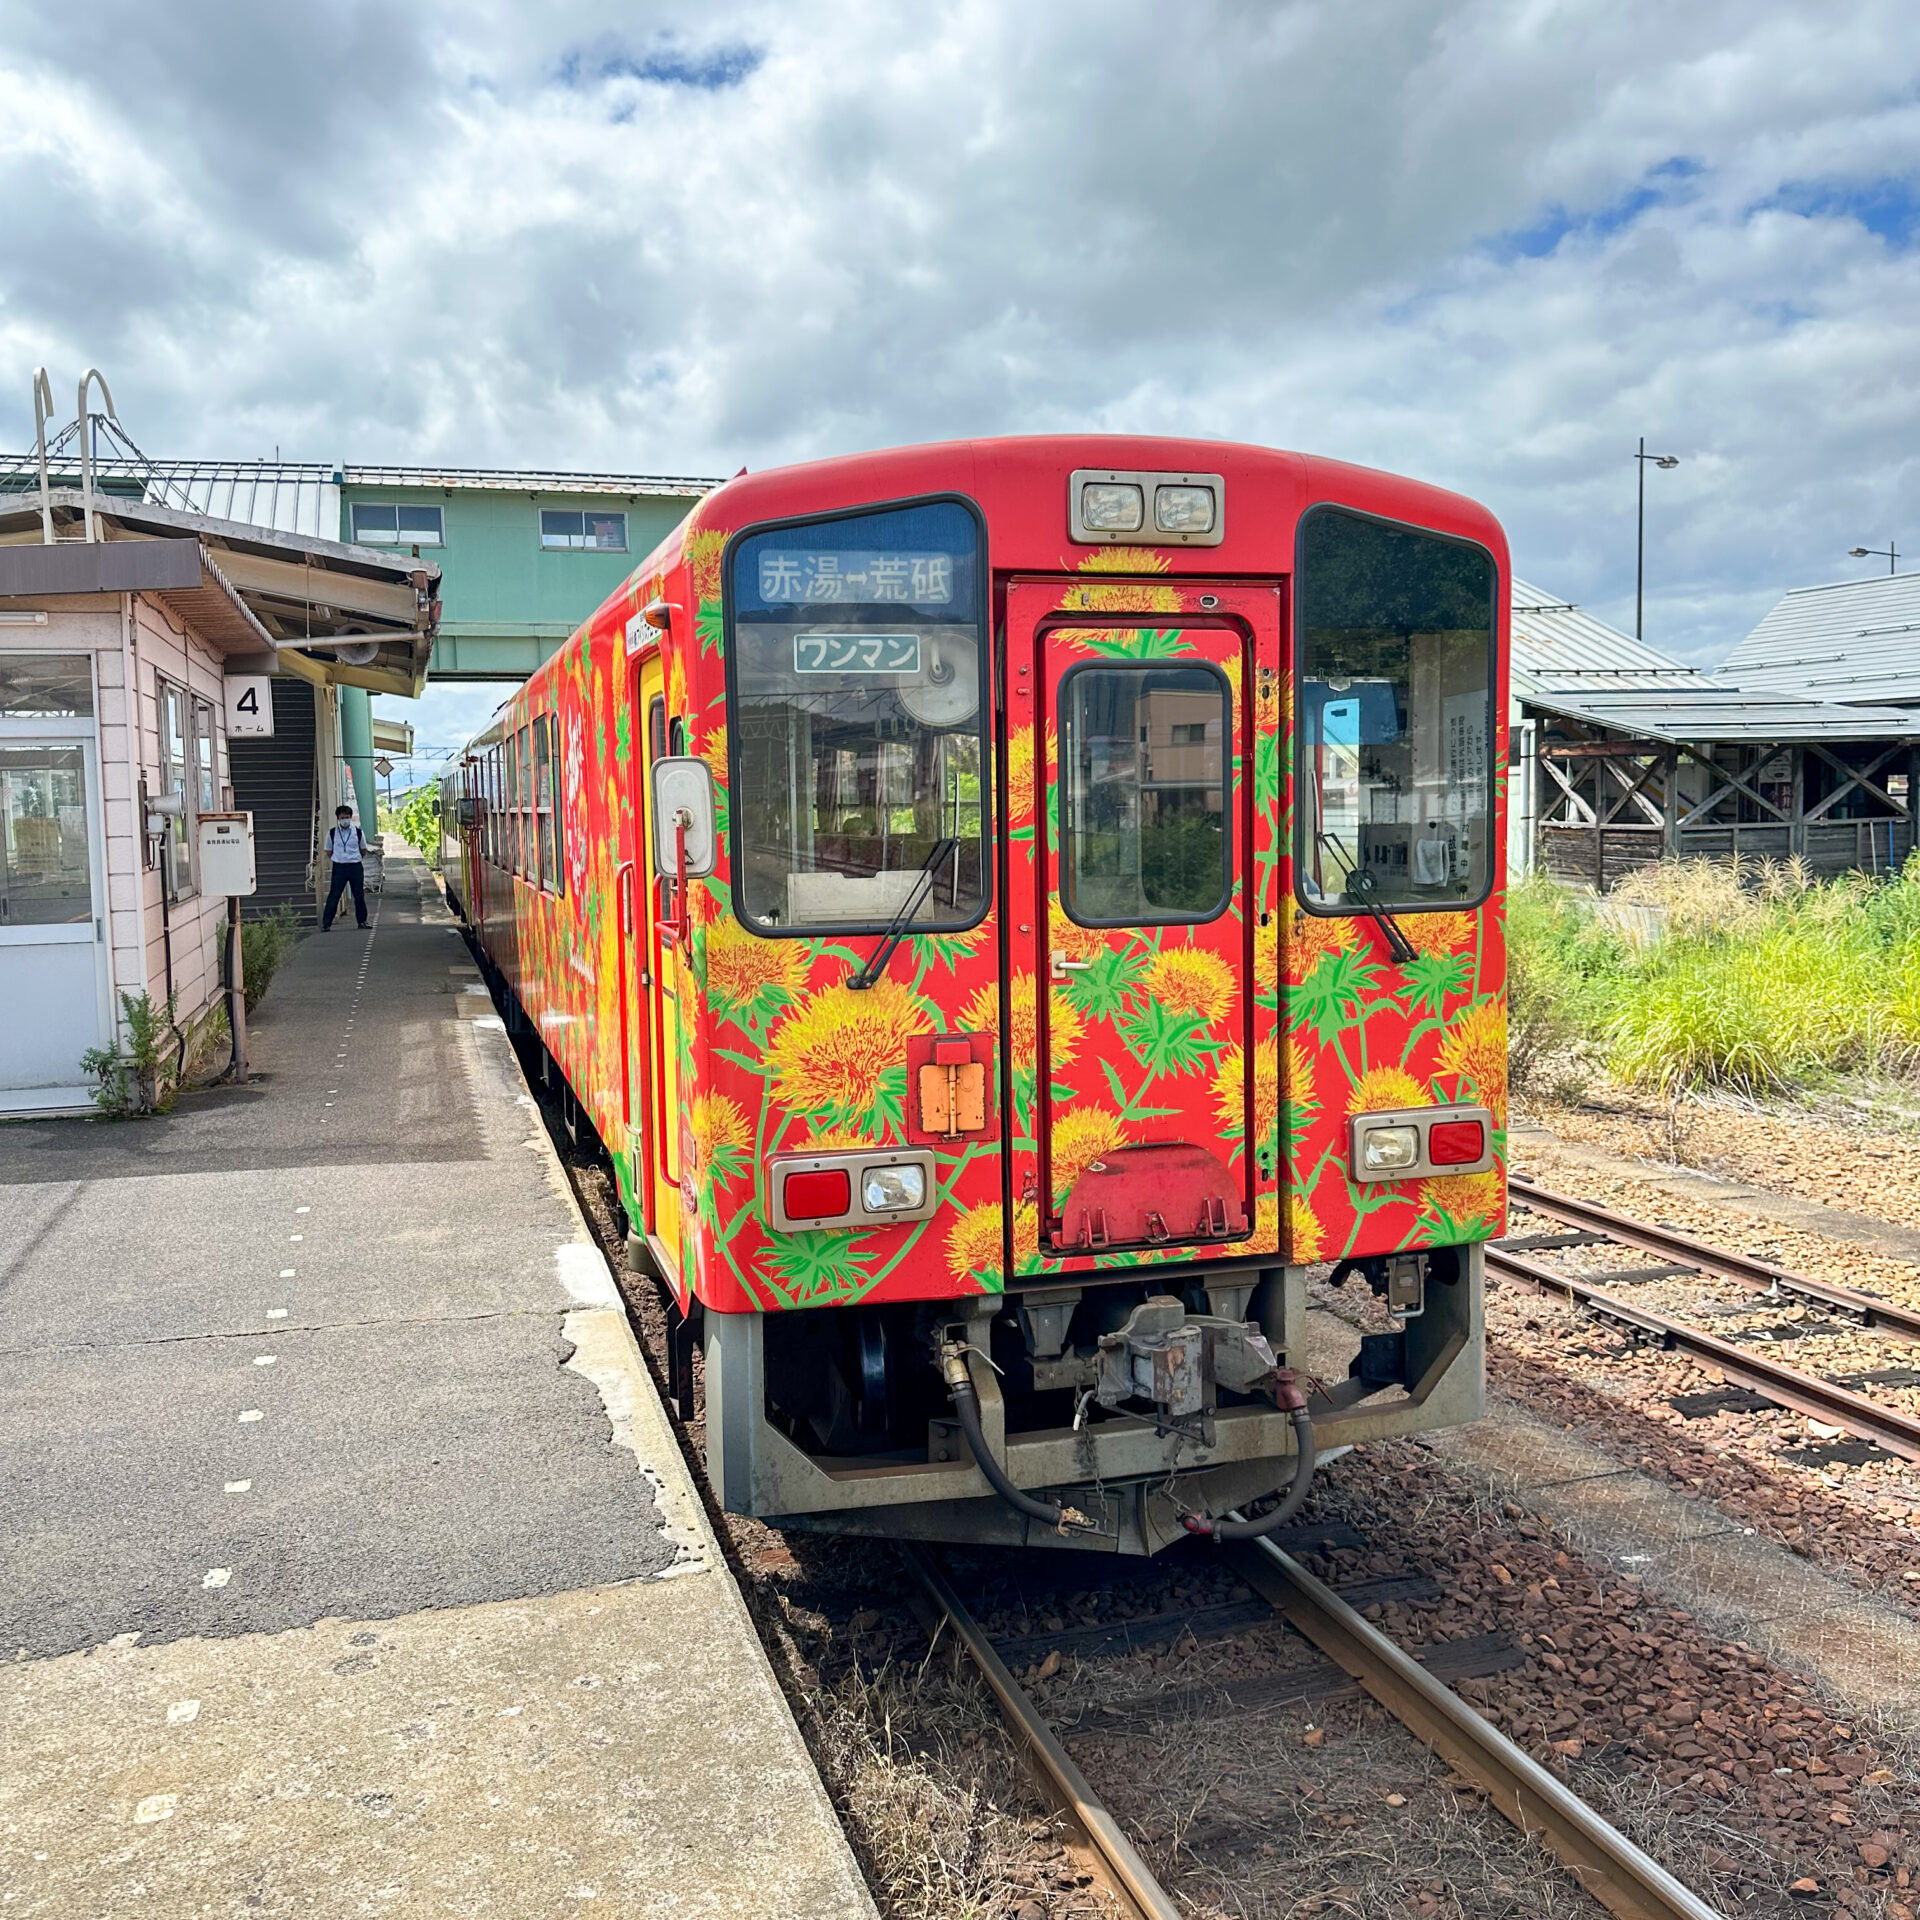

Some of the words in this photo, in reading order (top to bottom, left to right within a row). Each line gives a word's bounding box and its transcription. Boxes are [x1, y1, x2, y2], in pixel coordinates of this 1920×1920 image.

[762, 555, 844, 600] 赤湯
[870, 556, 950, 600] 荒砥
[799, 638, 916, 668] ワンマン
[236, 687, 259, 715] 4
[234, 725, 264, 733] ホーム
